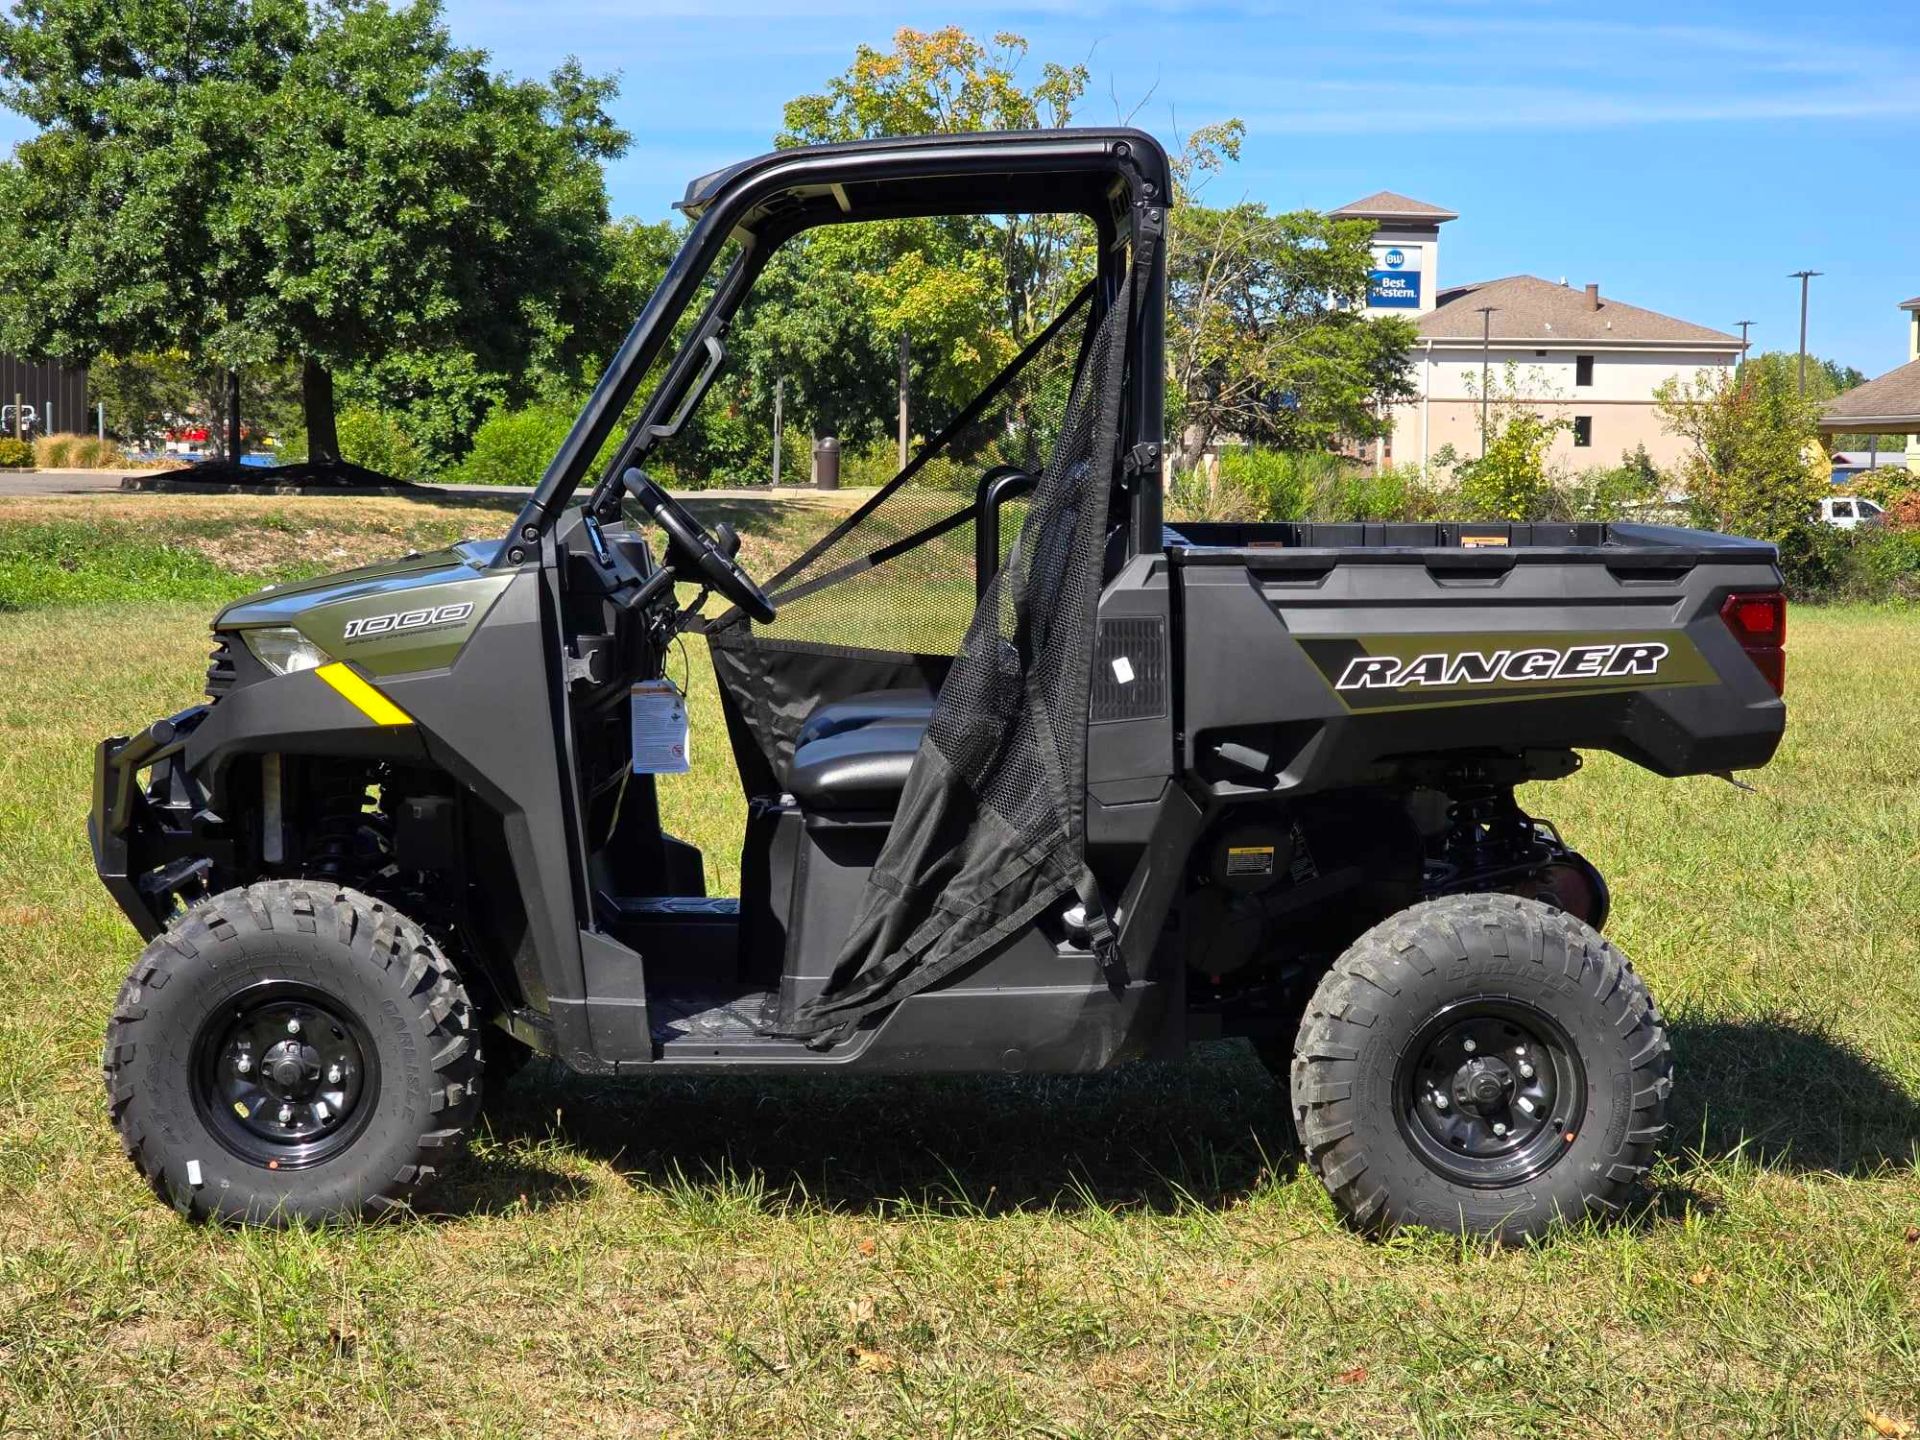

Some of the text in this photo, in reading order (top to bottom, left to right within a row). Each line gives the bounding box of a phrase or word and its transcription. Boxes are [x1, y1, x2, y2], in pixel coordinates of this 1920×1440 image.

[1386, 254, 1403, 264] BW
[1382, 277, 1406, 288] Best
[344, 602, 475, 638] 1000
[1334, 642, 1669, 690] RANGER
